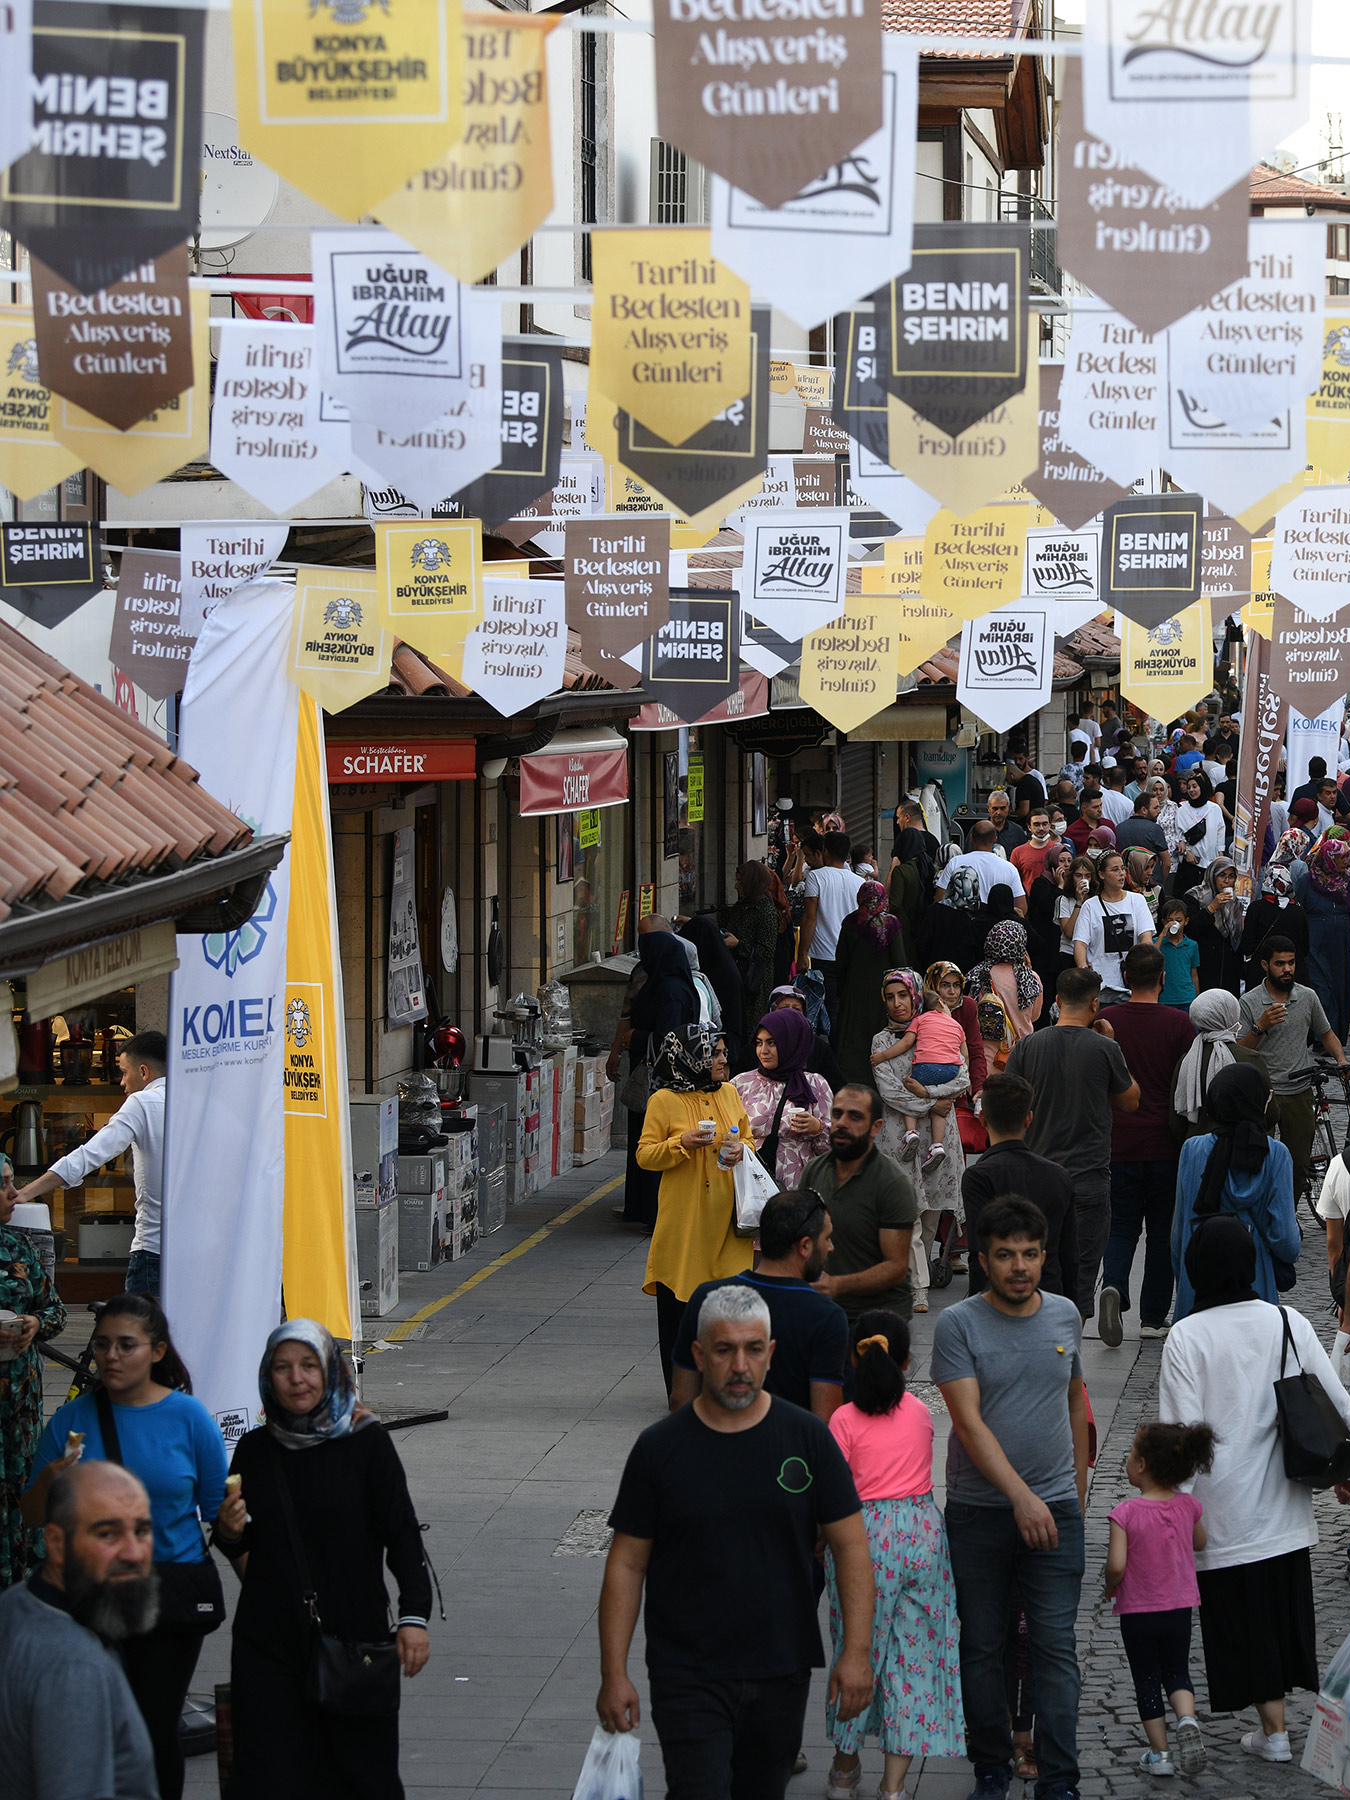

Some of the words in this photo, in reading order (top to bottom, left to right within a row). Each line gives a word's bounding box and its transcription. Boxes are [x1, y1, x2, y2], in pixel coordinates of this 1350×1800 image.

[313, 35, 387, 53] KONYA
[690, 27, 850, 72] Alışveriş
[702, 78, 841, 116] Günleri
[366, 264, 428, 285] UĞUR
[631, 258, 716, 285] Tarihi
[47, 290, 182, 317] Bedesten
[611, 293, 740, 320] Bedesten
[64, 320, 172, 348] Alışveriş
[345, 302, 451, 355] Altay
[1200, 320, 1303, 346] Alışveriş
[624, 327, 728, 354] Alışveriş
[73, 351, 167, 375] Günleri
[1207, 352, 1296, 376] Günleri
[632, 361, 722, 384] Günleri
[951, 522, 1006, 537] Tarihi
[206, 538, 265, 556] Tarihi
[588, 536, 646, 554] Tarihi
[779, 533, 820, 546] UĞUR
[934, 541, 1019, 557] Bedesten
[573, 558, 661, 576] Bedesten
[760, 556, 834, 588] Altay
[940, 558, 1009, 573] Alışveriş
[414, 574, 449, 584] KONYA
[943, 575, 1003, 590] Günleri
[1293, 568, 1350, 583] Günleri
[396, 583, 467, 598] BÜYÜKŞEHİR
[582, 579, 653, 598] Alışveriş
[411, 597, 453, 606] BELEDİYESİ
[586, 601, 648, 617] Günleri
[1293, 718, 1338, 732] KOMEK
[343, 756, 424, 774] SCHAFER
[66, 947, 101, 988] KONYA
[103, 931, 142, 974] TELEKOM
[182, 1047, 210, 1060] MESLEK
[290, 1054, 314, 1068] KONYA
